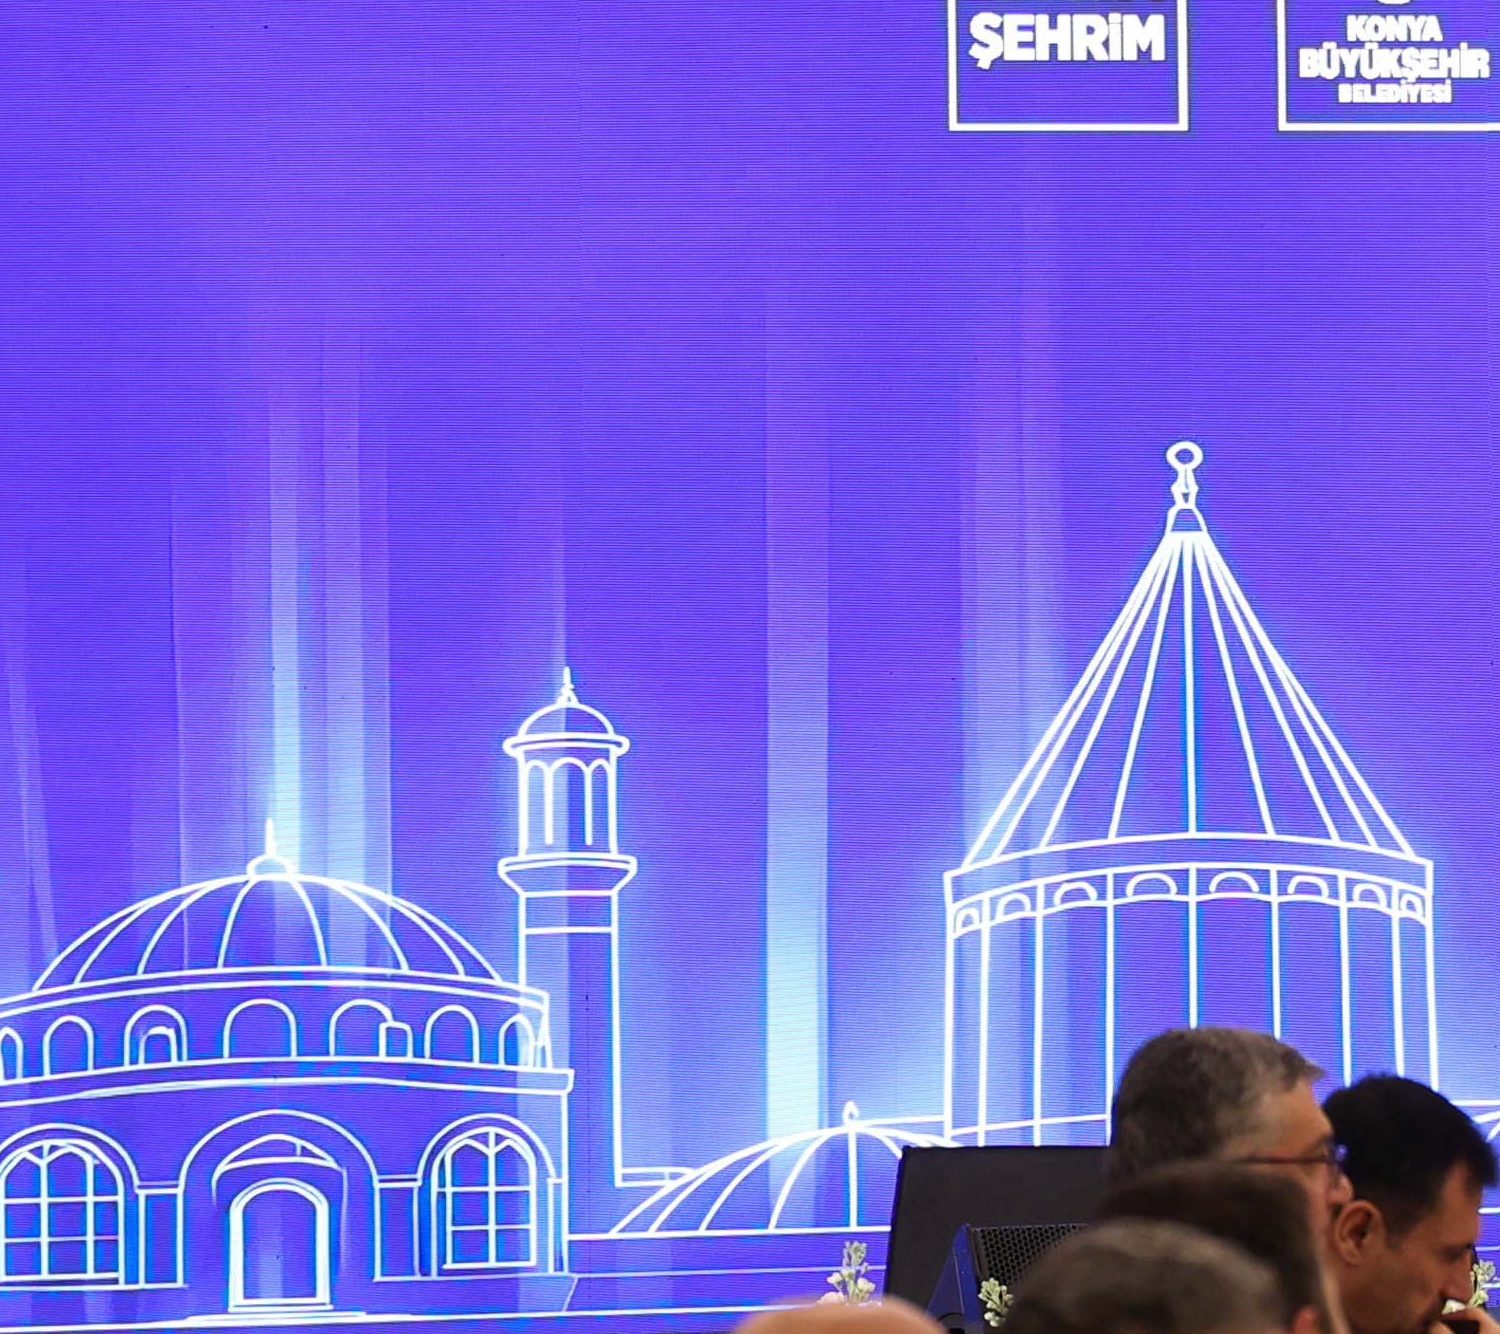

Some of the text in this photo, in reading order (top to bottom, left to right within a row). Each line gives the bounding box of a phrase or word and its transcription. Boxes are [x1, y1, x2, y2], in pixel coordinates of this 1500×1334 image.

[1345, 14, 1445, 44] KONYA
[1298, 41, 1491, 85] BÜYÜKŞEHİR
[1336, 79, 1453, 105] BELEDİYESİ
